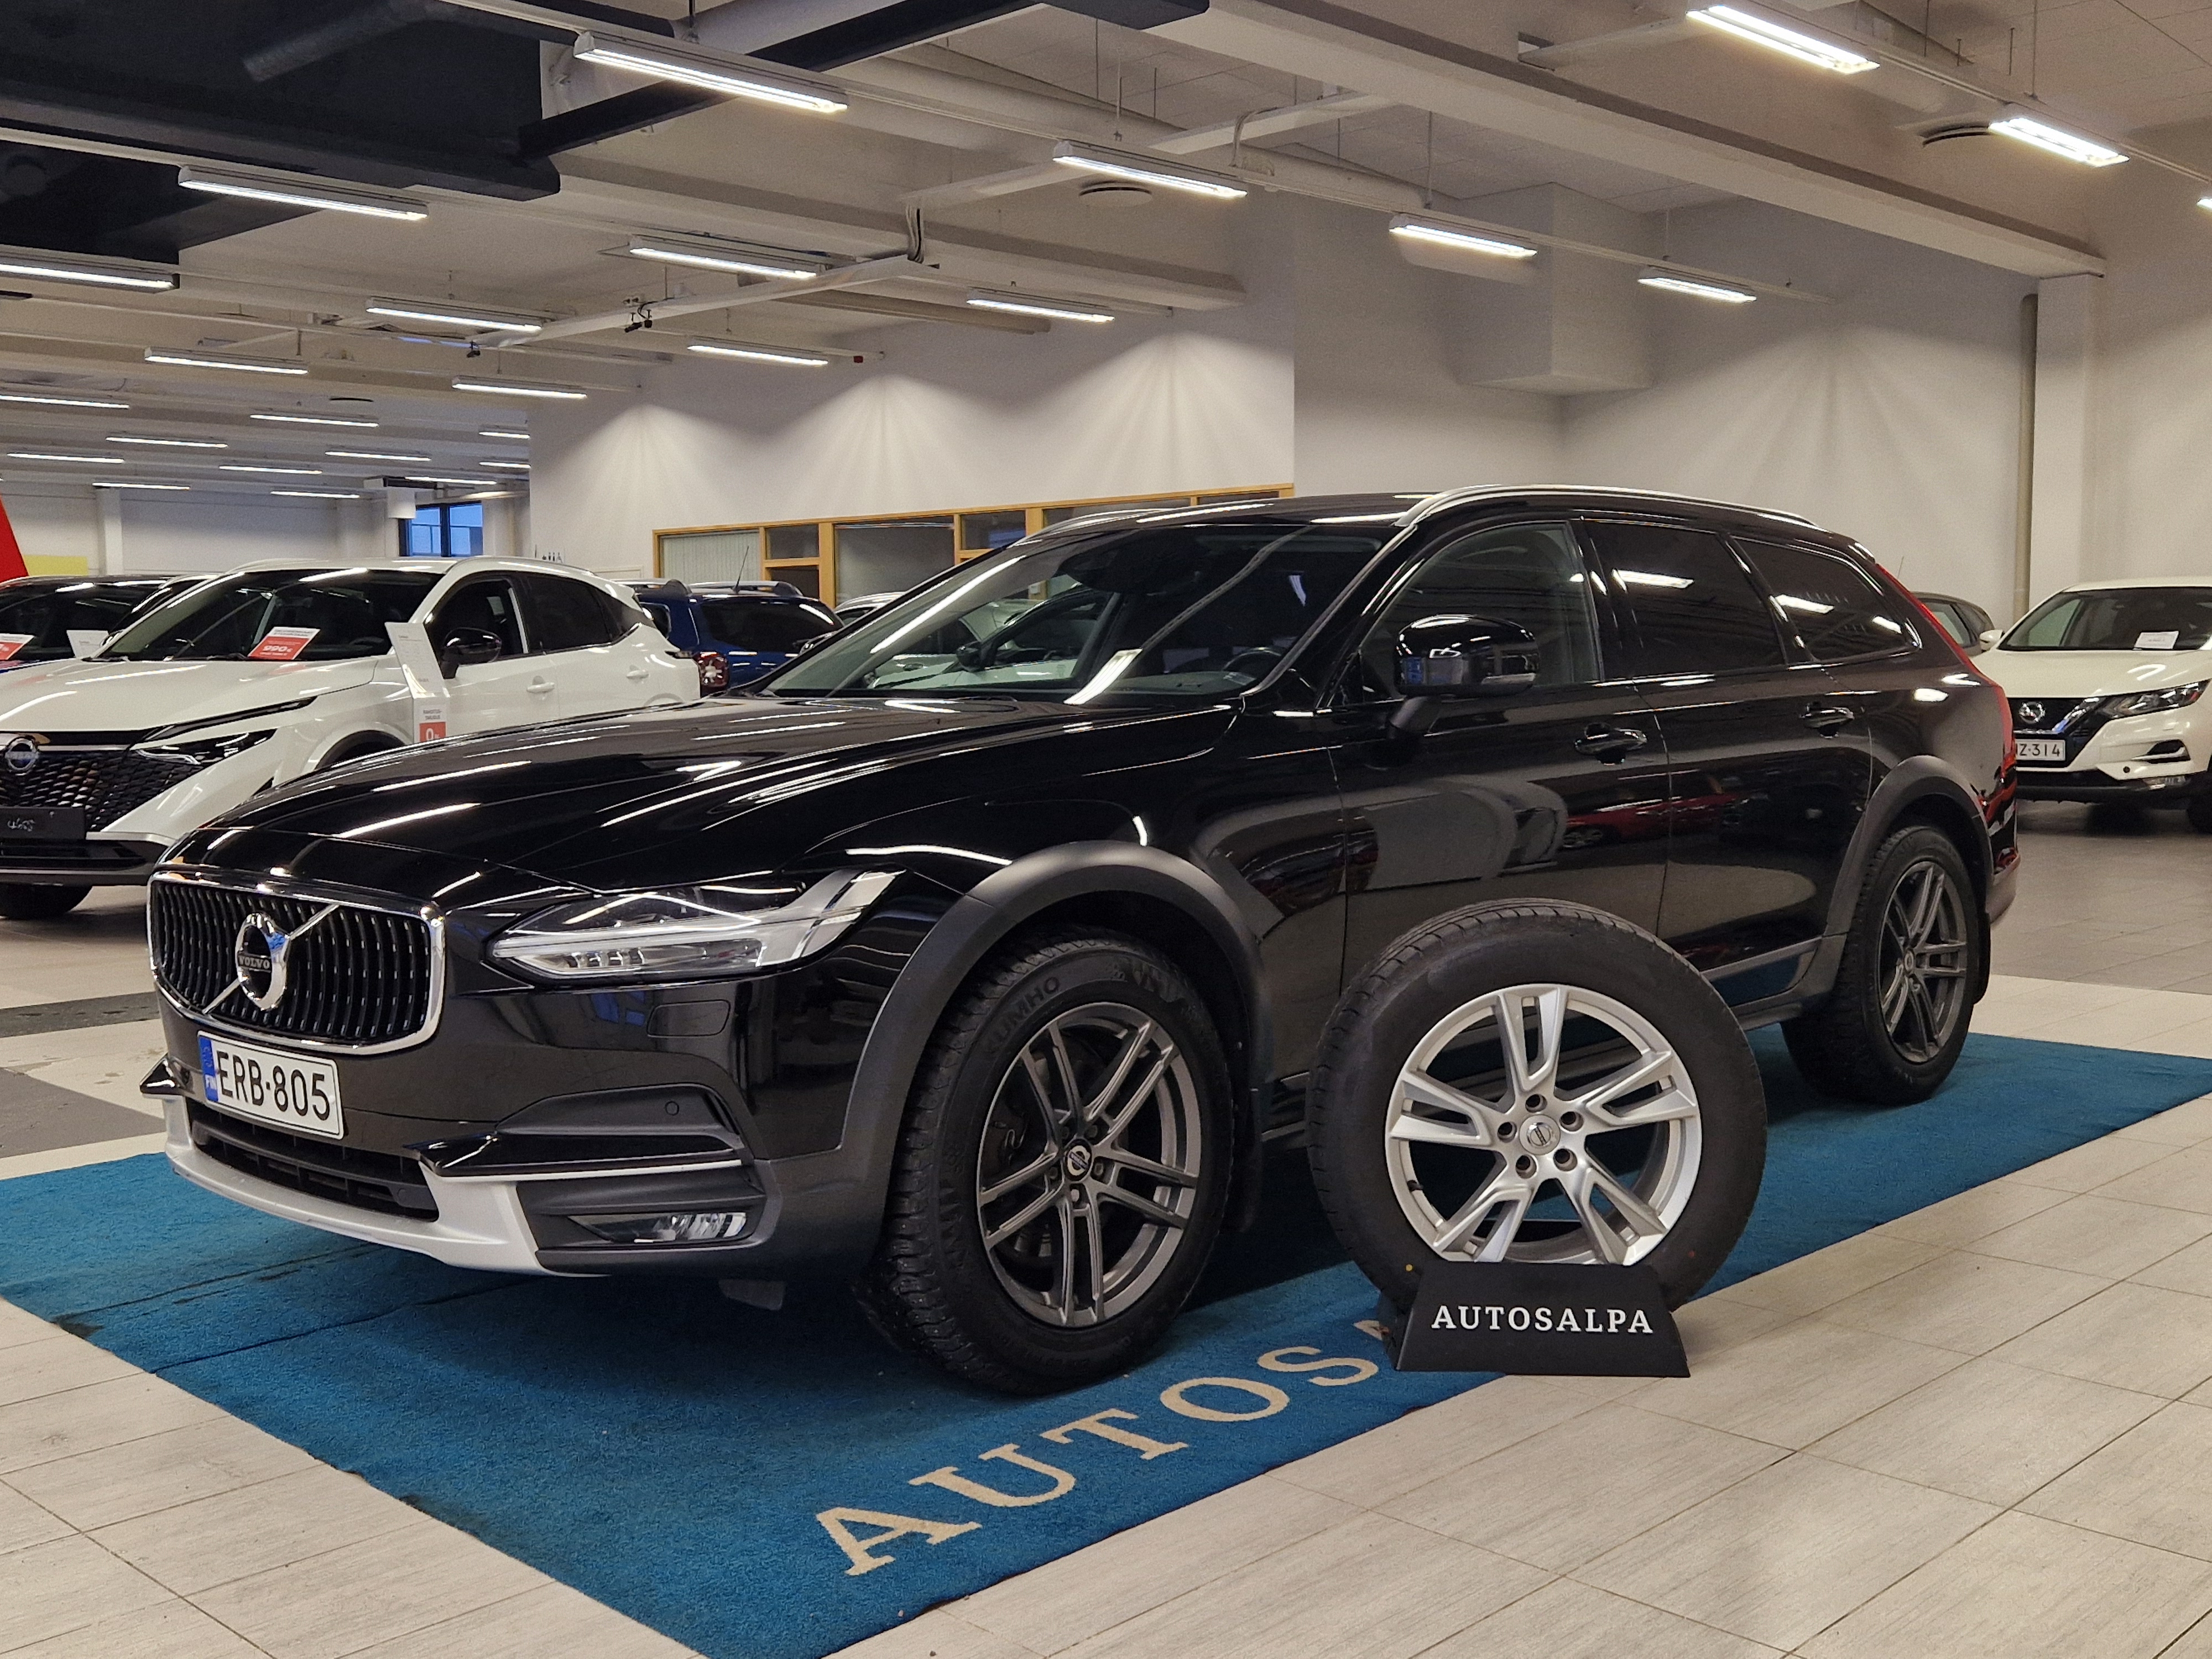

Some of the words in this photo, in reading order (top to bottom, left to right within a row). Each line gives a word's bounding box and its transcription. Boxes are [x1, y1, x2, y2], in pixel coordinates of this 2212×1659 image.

[2016, 744, 2060, 757] Z-314
[238, 955, 270, 969] VOLVO
[216, 1050, 330, 1121] ERB-805
[1431, 1305, 1653, 1333] AUTOSALPA
[816, 1319, 1389, 1576] AUTOS
